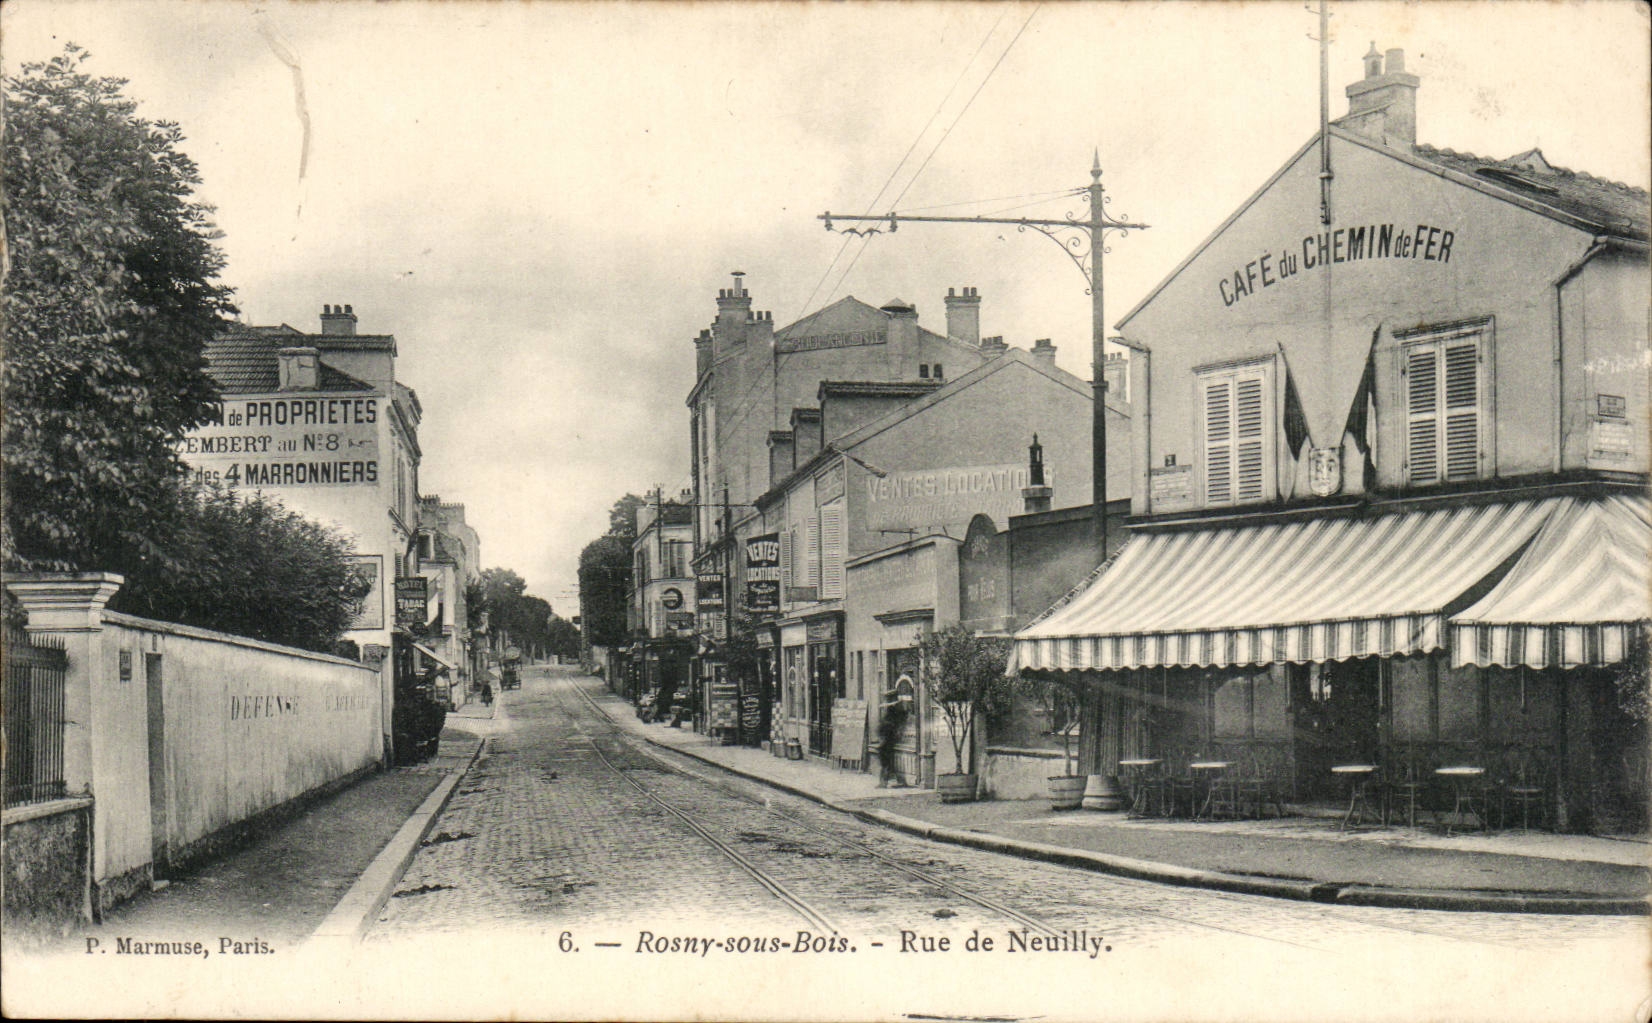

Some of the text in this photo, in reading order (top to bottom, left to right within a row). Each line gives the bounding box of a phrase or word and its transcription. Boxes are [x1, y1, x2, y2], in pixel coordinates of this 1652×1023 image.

[1219, 224, 1455, 307] CAFÉ du CHEMIN de FER
[228, 409, 243, 426] de
[246, 400, 377, 426] PROPRIETES
[277, 439, 297, 451] au
[224, 463, 241, 486] 4
[245, 461, 378, 485] MARRONNIERS
[867, 474, 936, 502] VENTES
[746, 541, 779, 561] VENTES
